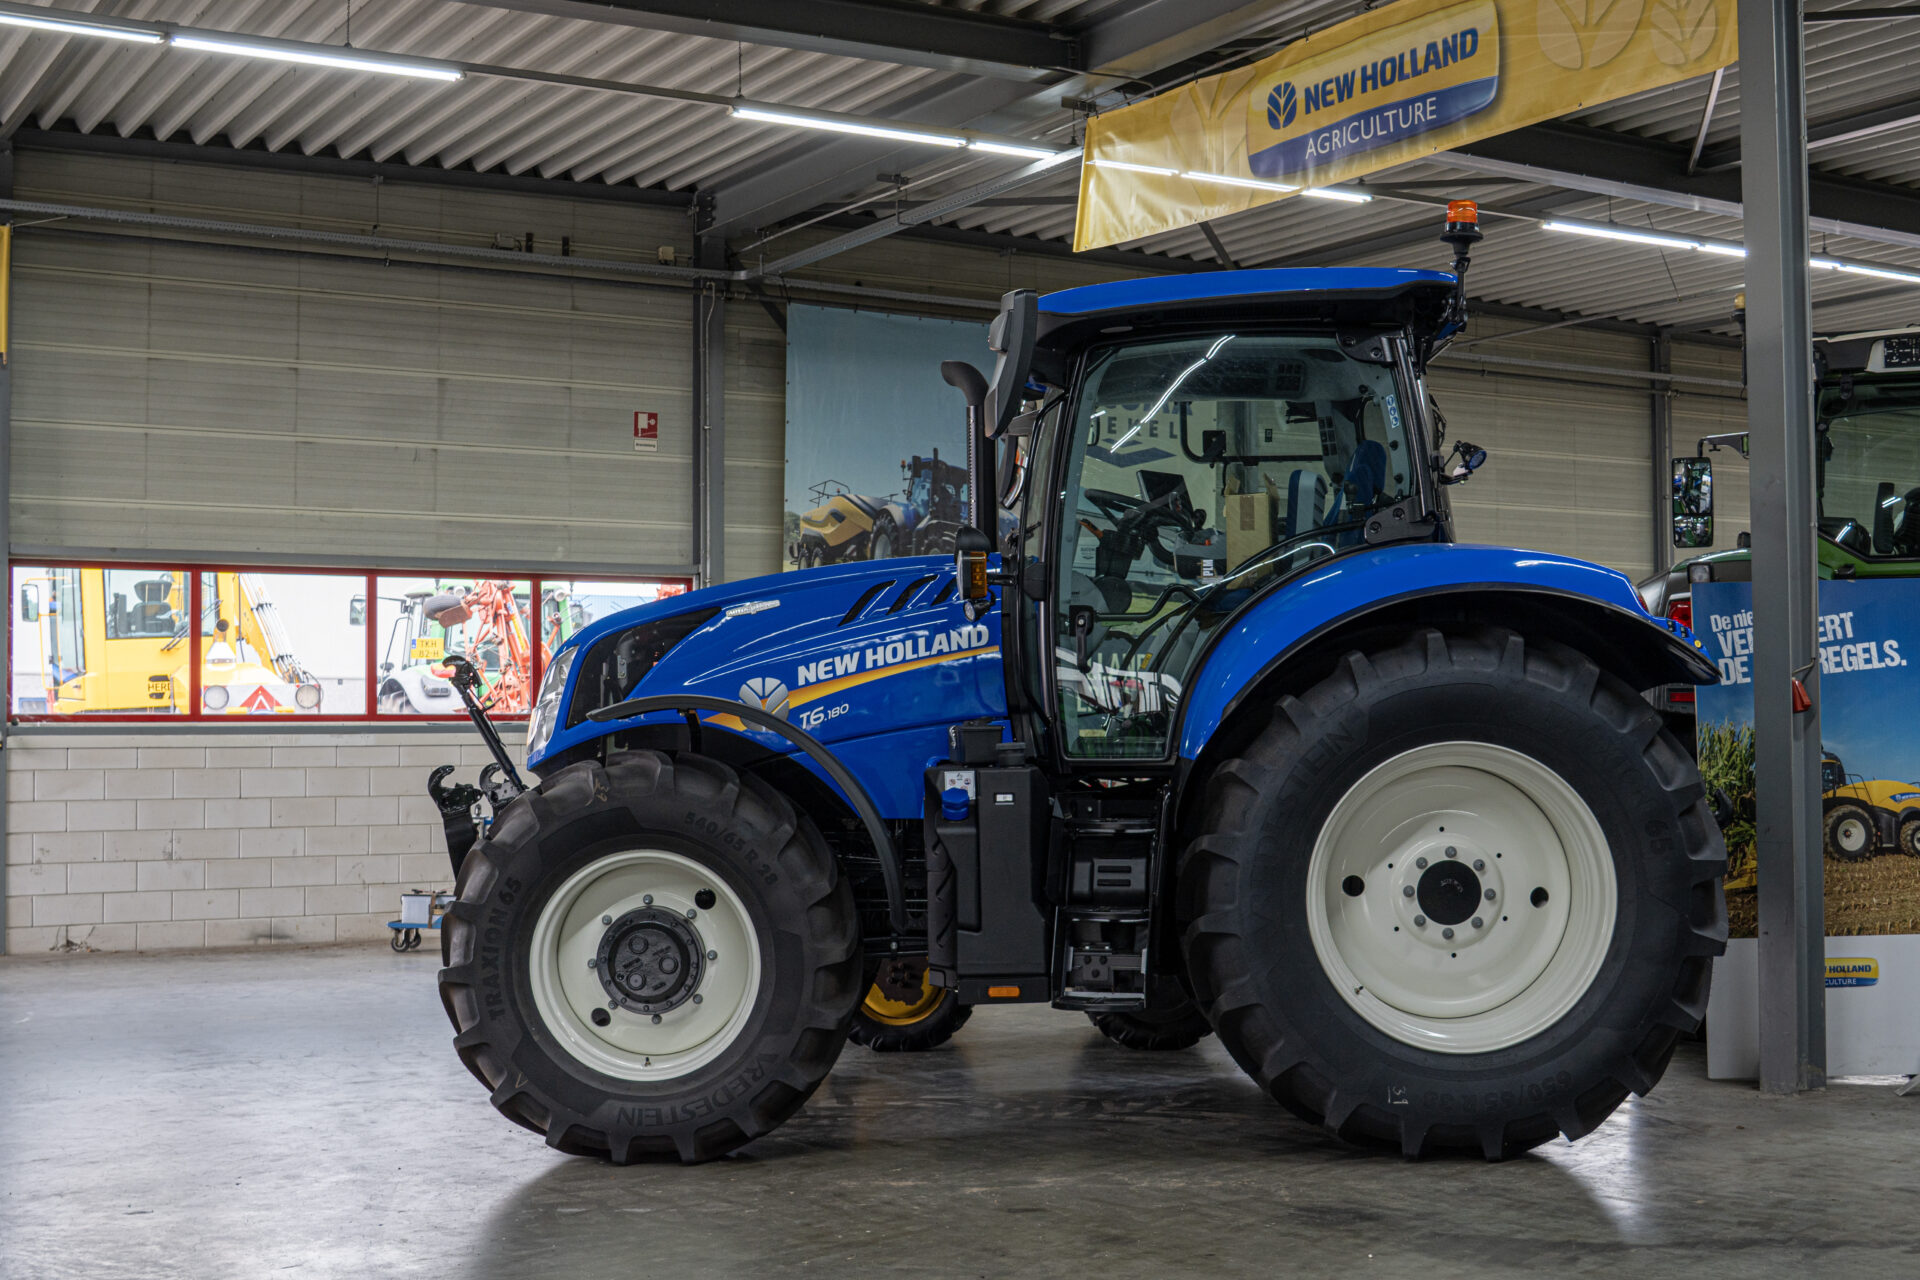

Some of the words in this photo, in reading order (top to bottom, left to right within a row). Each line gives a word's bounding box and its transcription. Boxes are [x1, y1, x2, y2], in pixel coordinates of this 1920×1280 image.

[1305, 69, 1356, 115] NEW
[1361, 27, 1479, 94] HOLLAND
[1305, 97, 1437, 160] AGRICULTURE
[1710, 614, 1732, 633] De
[797, 651, 860, 686] NEW
[865, 624, 990, 670] HOLLAND
[1718, 656, 1751, 687] DE
[799, 703, 849, 730] T6.180
[684, 811, 746, 850] 540/65
[744, 848, 759, 864] R
[757, 863, 779, 886] 28
[481, 908, 507, 1022] TRAXION
[497, 876, 522, 906] 65
[1829, 964, 1871, 974] HOLLAND
[616, 1053, 779, 1127] VREDESTEIN
